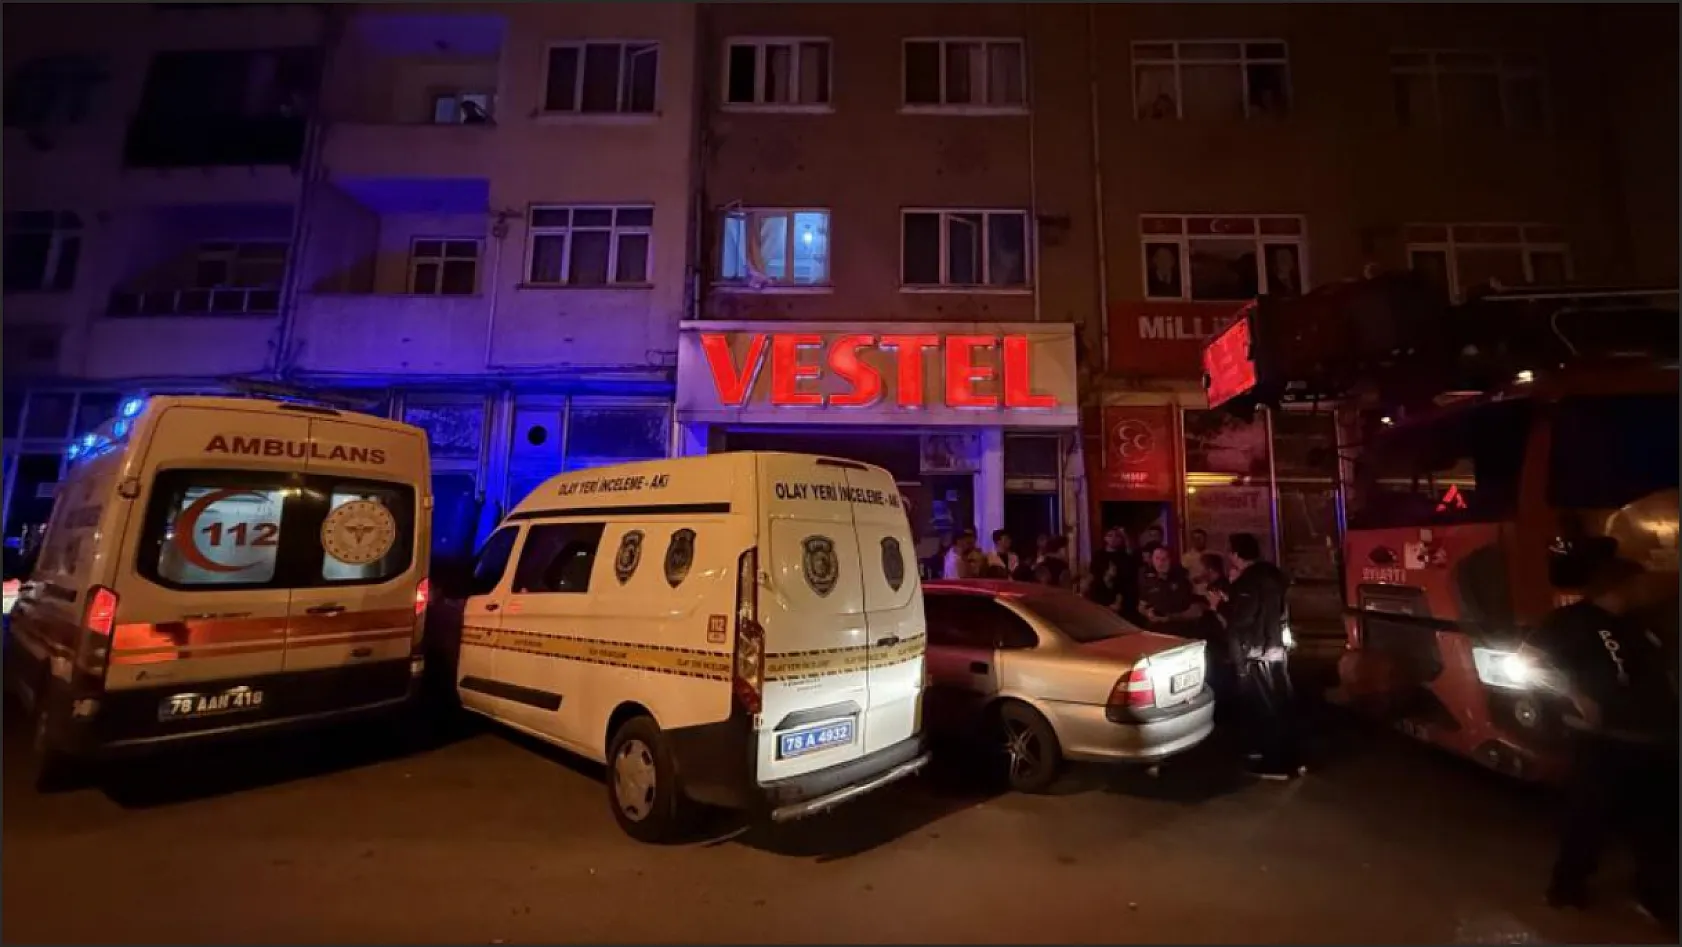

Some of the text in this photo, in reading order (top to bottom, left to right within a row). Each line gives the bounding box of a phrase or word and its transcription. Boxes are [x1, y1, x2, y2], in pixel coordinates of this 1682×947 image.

[700, 333, 1060, 410] VESTEL
[204, 435, 386, 465] AMBULANS
[775, 482, 808, 500] OLAY
[202, 522, 279, 546] 112
[170, 699, 193, 715] 78
[786, 725, 849, 751] 78 A 4932
